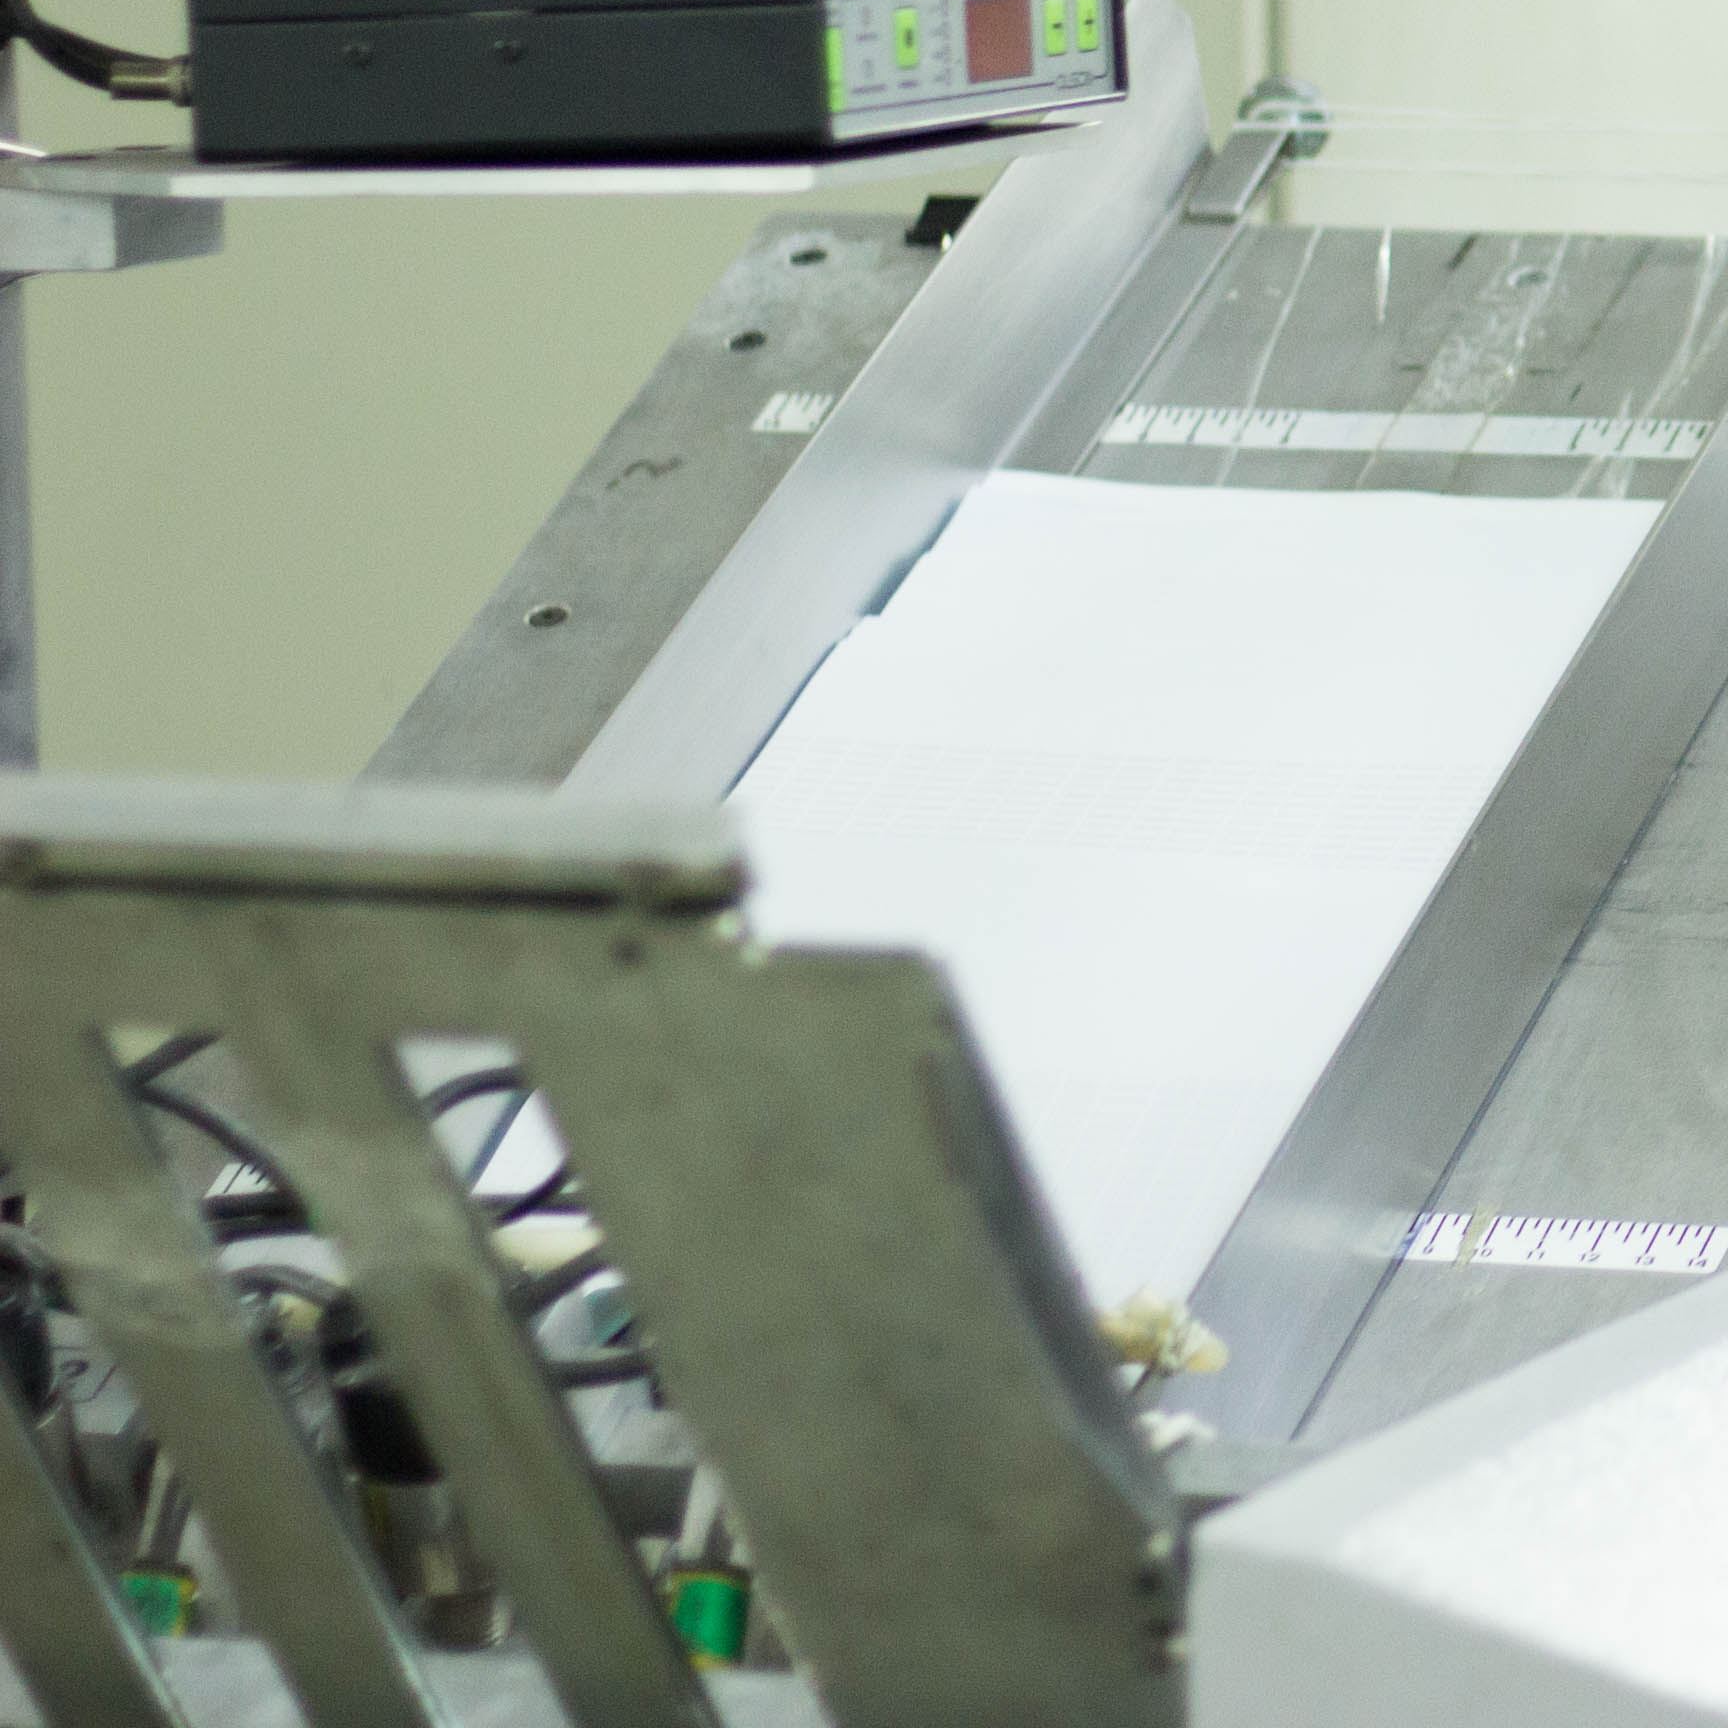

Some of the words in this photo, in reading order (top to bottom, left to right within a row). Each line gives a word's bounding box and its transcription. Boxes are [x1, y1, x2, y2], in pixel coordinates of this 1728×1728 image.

[1422, 1245, 1434, 1255] 9
[1471, 1248, 1493, 1258] 10
[1526, 1250, 1546, 1260] 11
[1580, 1253, 1601, 1262] 12
[1635, 1255, 1655, 1265] 13
[1688, 1258, 1707, 1268] 14
